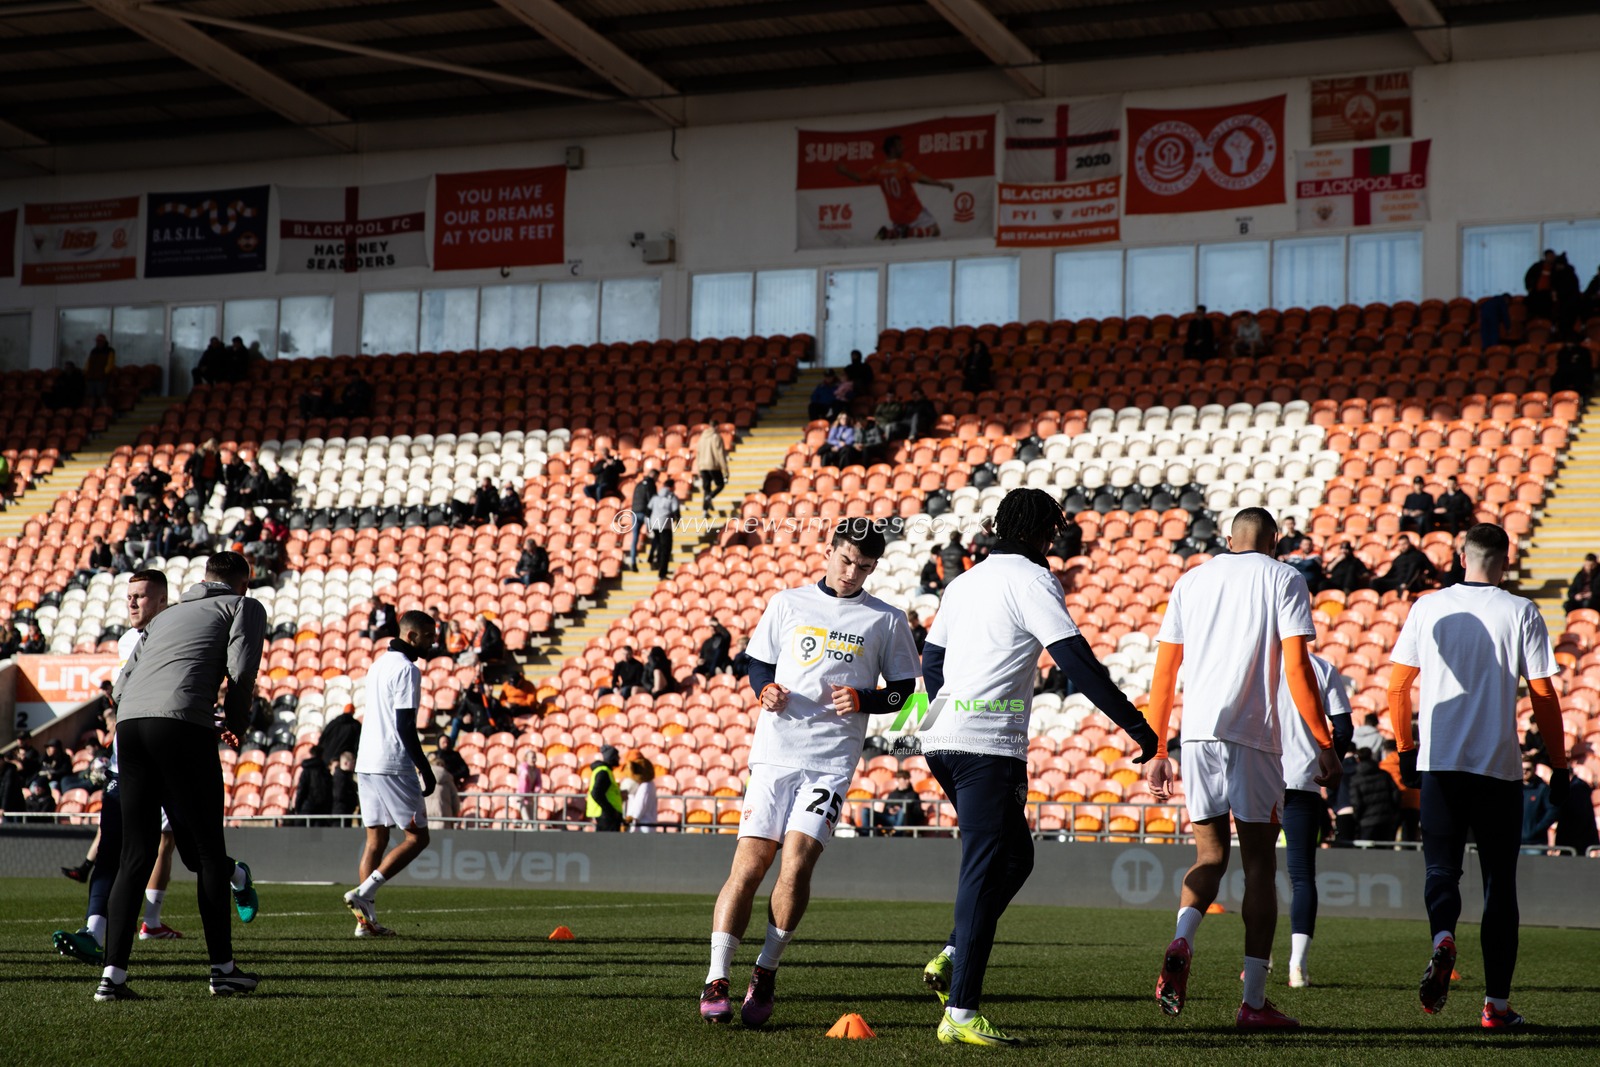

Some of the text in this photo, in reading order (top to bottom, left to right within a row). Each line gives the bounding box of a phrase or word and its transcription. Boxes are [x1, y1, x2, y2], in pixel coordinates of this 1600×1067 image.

[805, 141, 875, 163] SUPER
[918, 130, 988, 154] BRETT
[1076, 153, 1111, 169] 2020
[1001, 181, 1117, 202] BLACKPOOL FC
[1299, 173, 1424, 197] BLACKPOOL FC
[457, 184, 543, 206] YOU HAVE
[443, 203, 555, 226] OUR DREAMS
[819, 203, 854, 222] FY6
[293, 217, 411, 237] BLACKPOOL FC
[442, 224, 555, 246] AT YOUR FEET
[1240, 222, 1250, 236] B
[314, 240, 389, 256] HACKNEY
[306, 253, 396, 271] SEASIDERS
[571, 264, 578, 276] C
[827, 639, 865, 657] GAME
[829, 630, 865, 647] #HER
[826, 649, 854, 664] TOO
[17, 711, 28, 728] 2
[805, 787, 843, 824] 25
[407, 838, 590, 883] eleven
